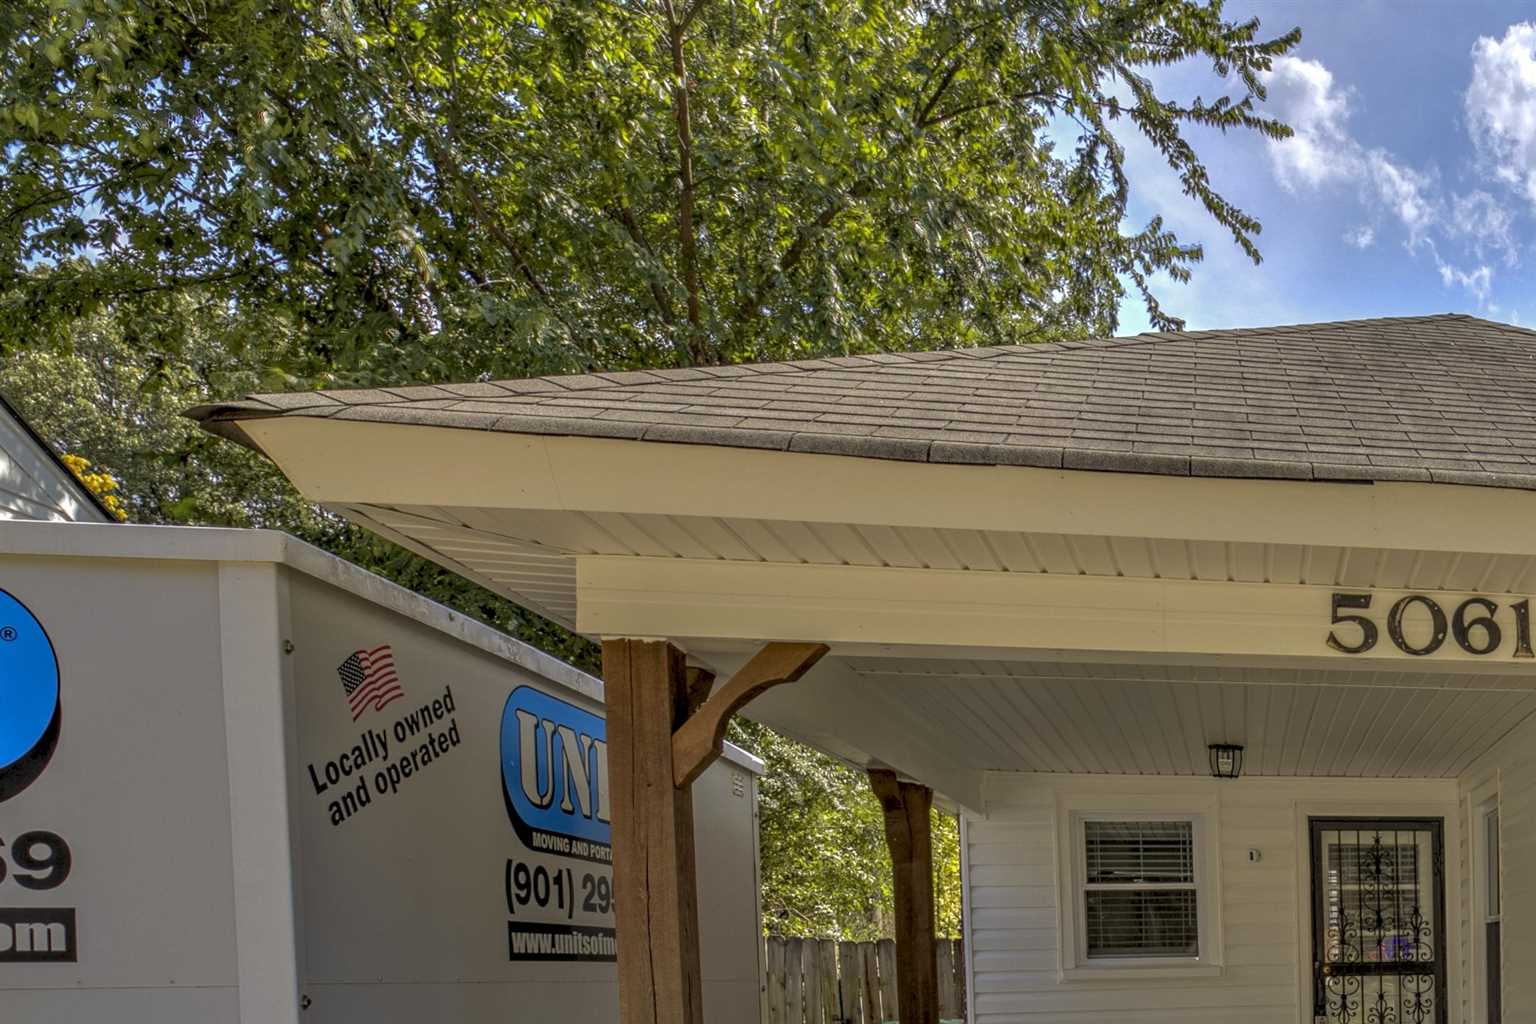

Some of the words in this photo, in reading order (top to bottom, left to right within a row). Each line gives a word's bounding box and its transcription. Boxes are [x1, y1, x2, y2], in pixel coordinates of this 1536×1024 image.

[1326, 592, 1535, 658] 5061
[308, 729, 389, 795] Locally
[394, 684, 456, 743] owned
[328, 775, 372, 826] and
[375, 718, 461, 794] operated
[0, 830, 72, 890] 9
[532, 831, 570, 853] MOVING
[571, 841, 590, 857] AND
[505, 858, 575, 919] (901)
[582, 873, 616, 914] 29
[511, 930, 617, 955] www.unitsofm
